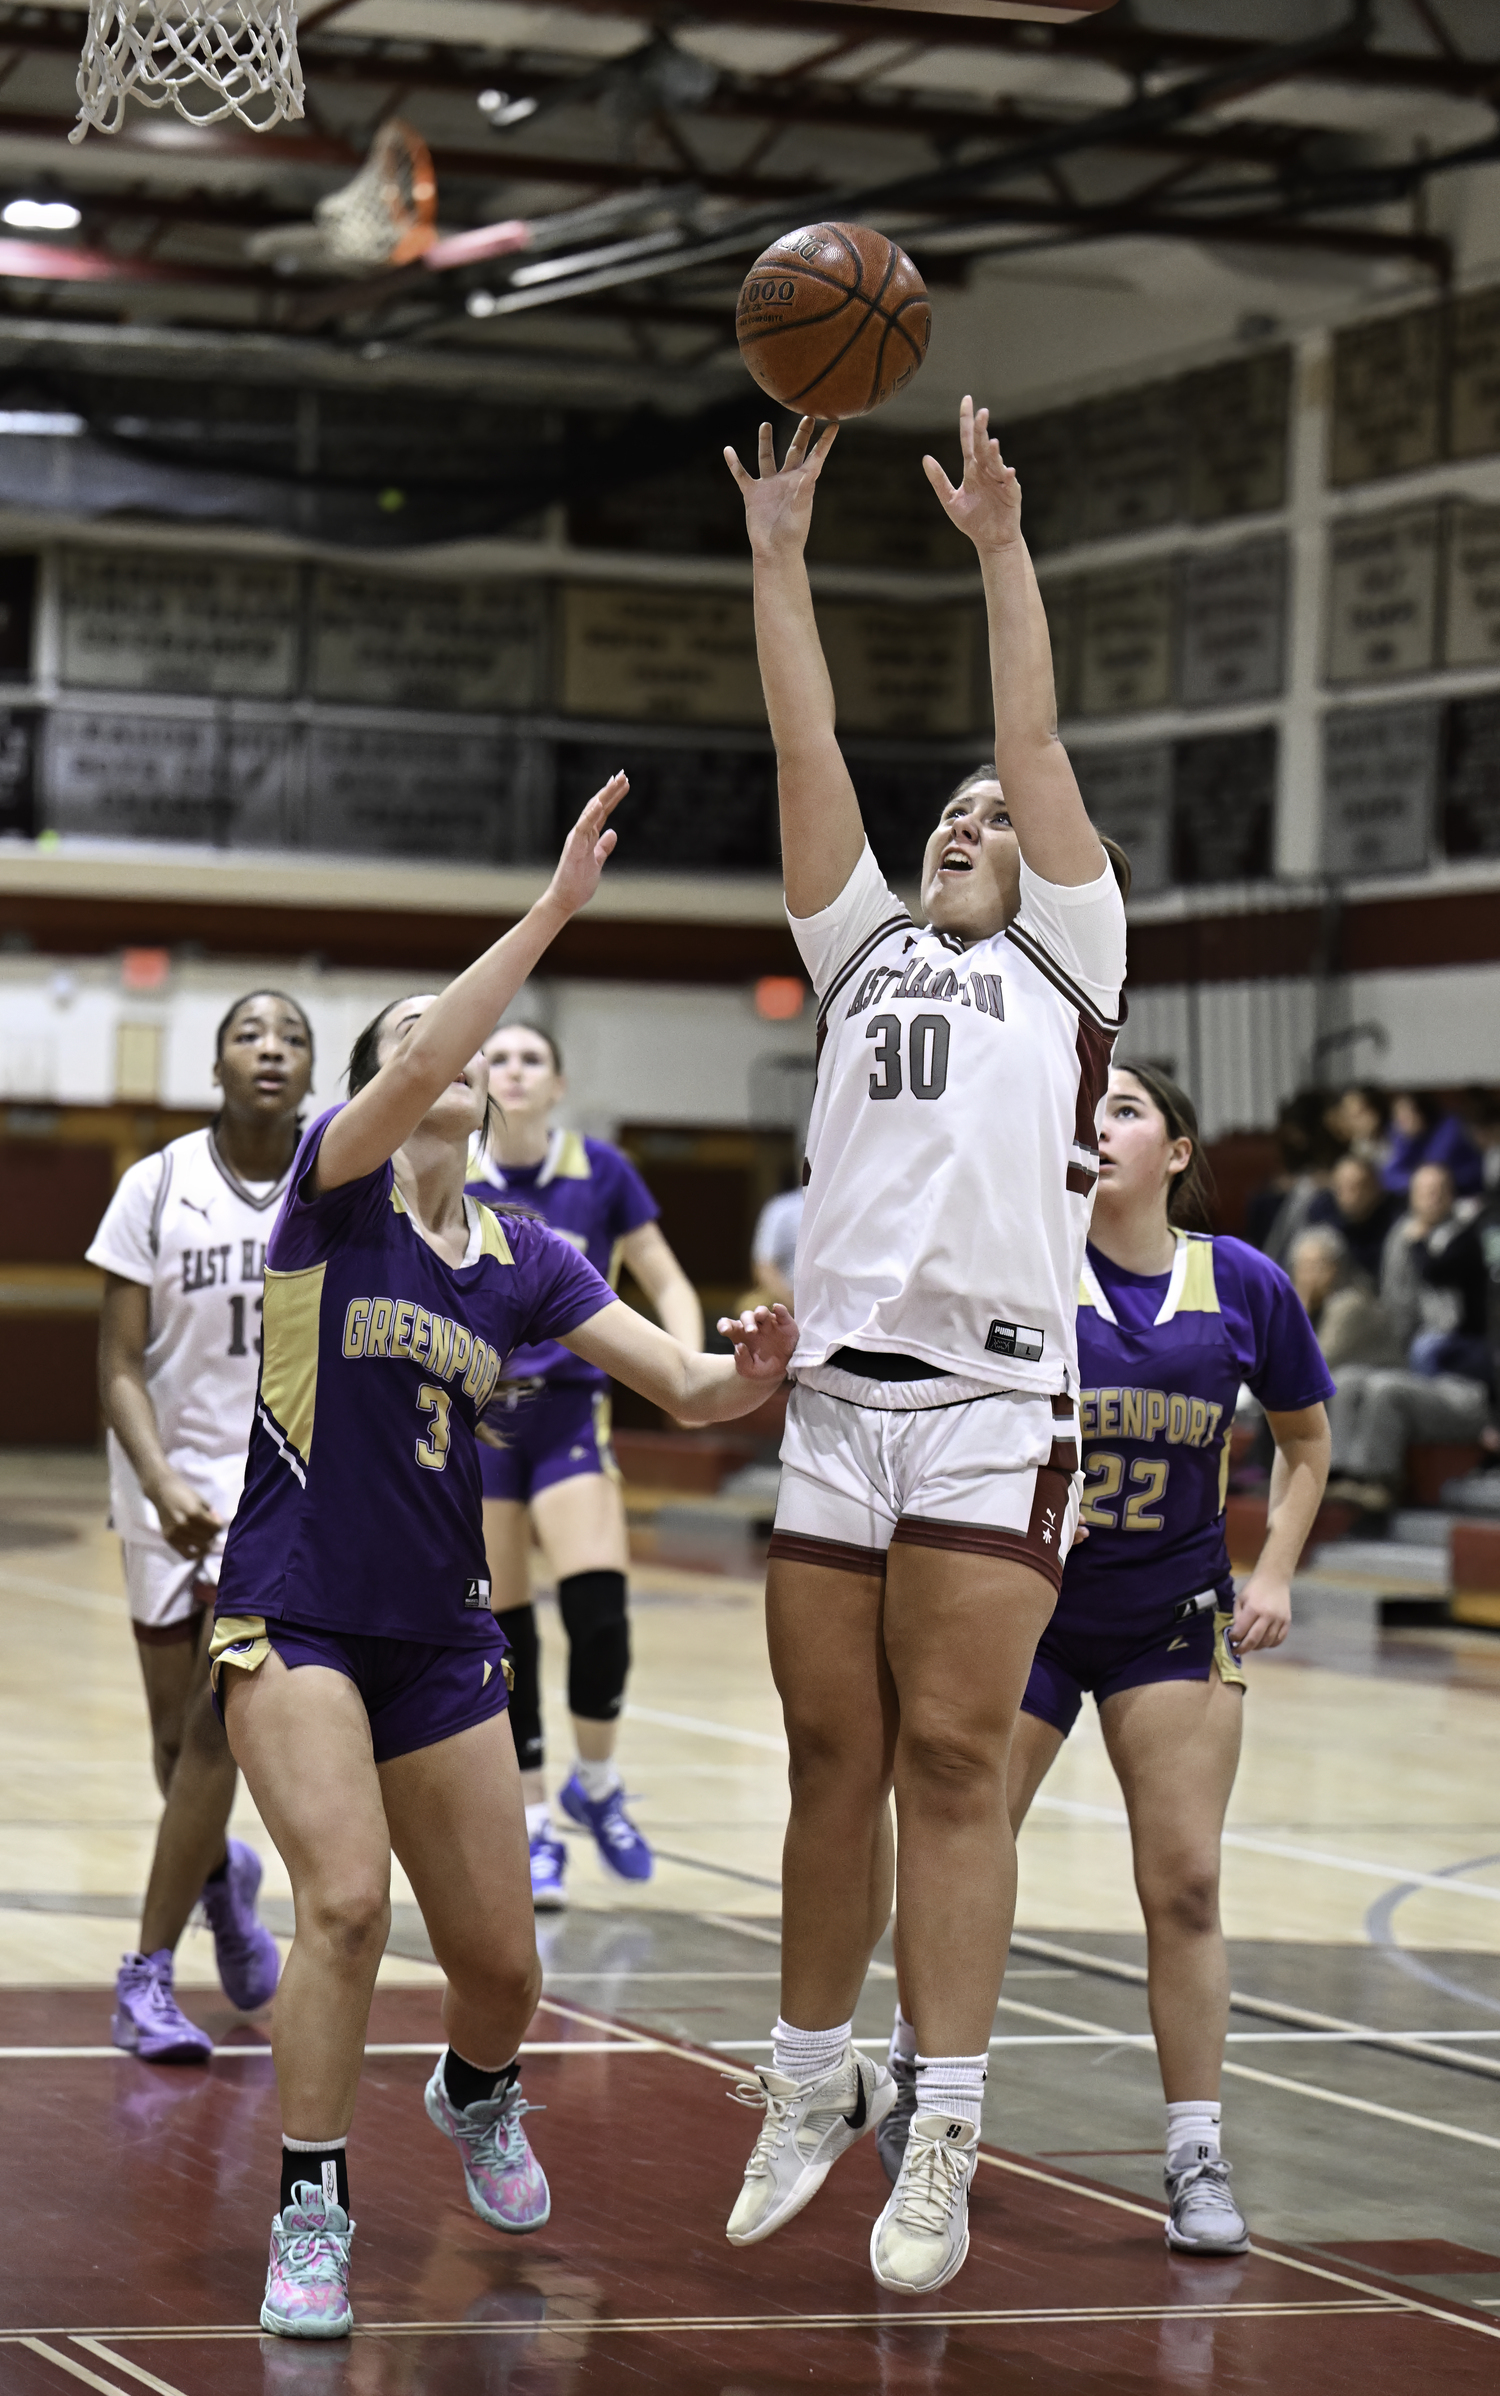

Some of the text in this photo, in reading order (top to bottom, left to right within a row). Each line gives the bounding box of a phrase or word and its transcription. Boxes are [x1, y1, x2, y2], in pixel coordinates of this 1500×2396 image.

[845, 966, 904, 1020] AST
[866, 1014, 951, 1100] 30
[182, 1244, 231, 1294] EAST
[342, 1297, 502, 1416] GREENPOR
[994, 1325, 1015, 1338] PUMA
[1025, 1346, 1031, 1355] L
[415, 1382, 452, 1472] 3
[1079, 1386, 1223, 1448] EENPORT
[1079, 1451, 1170, 1531] 22
